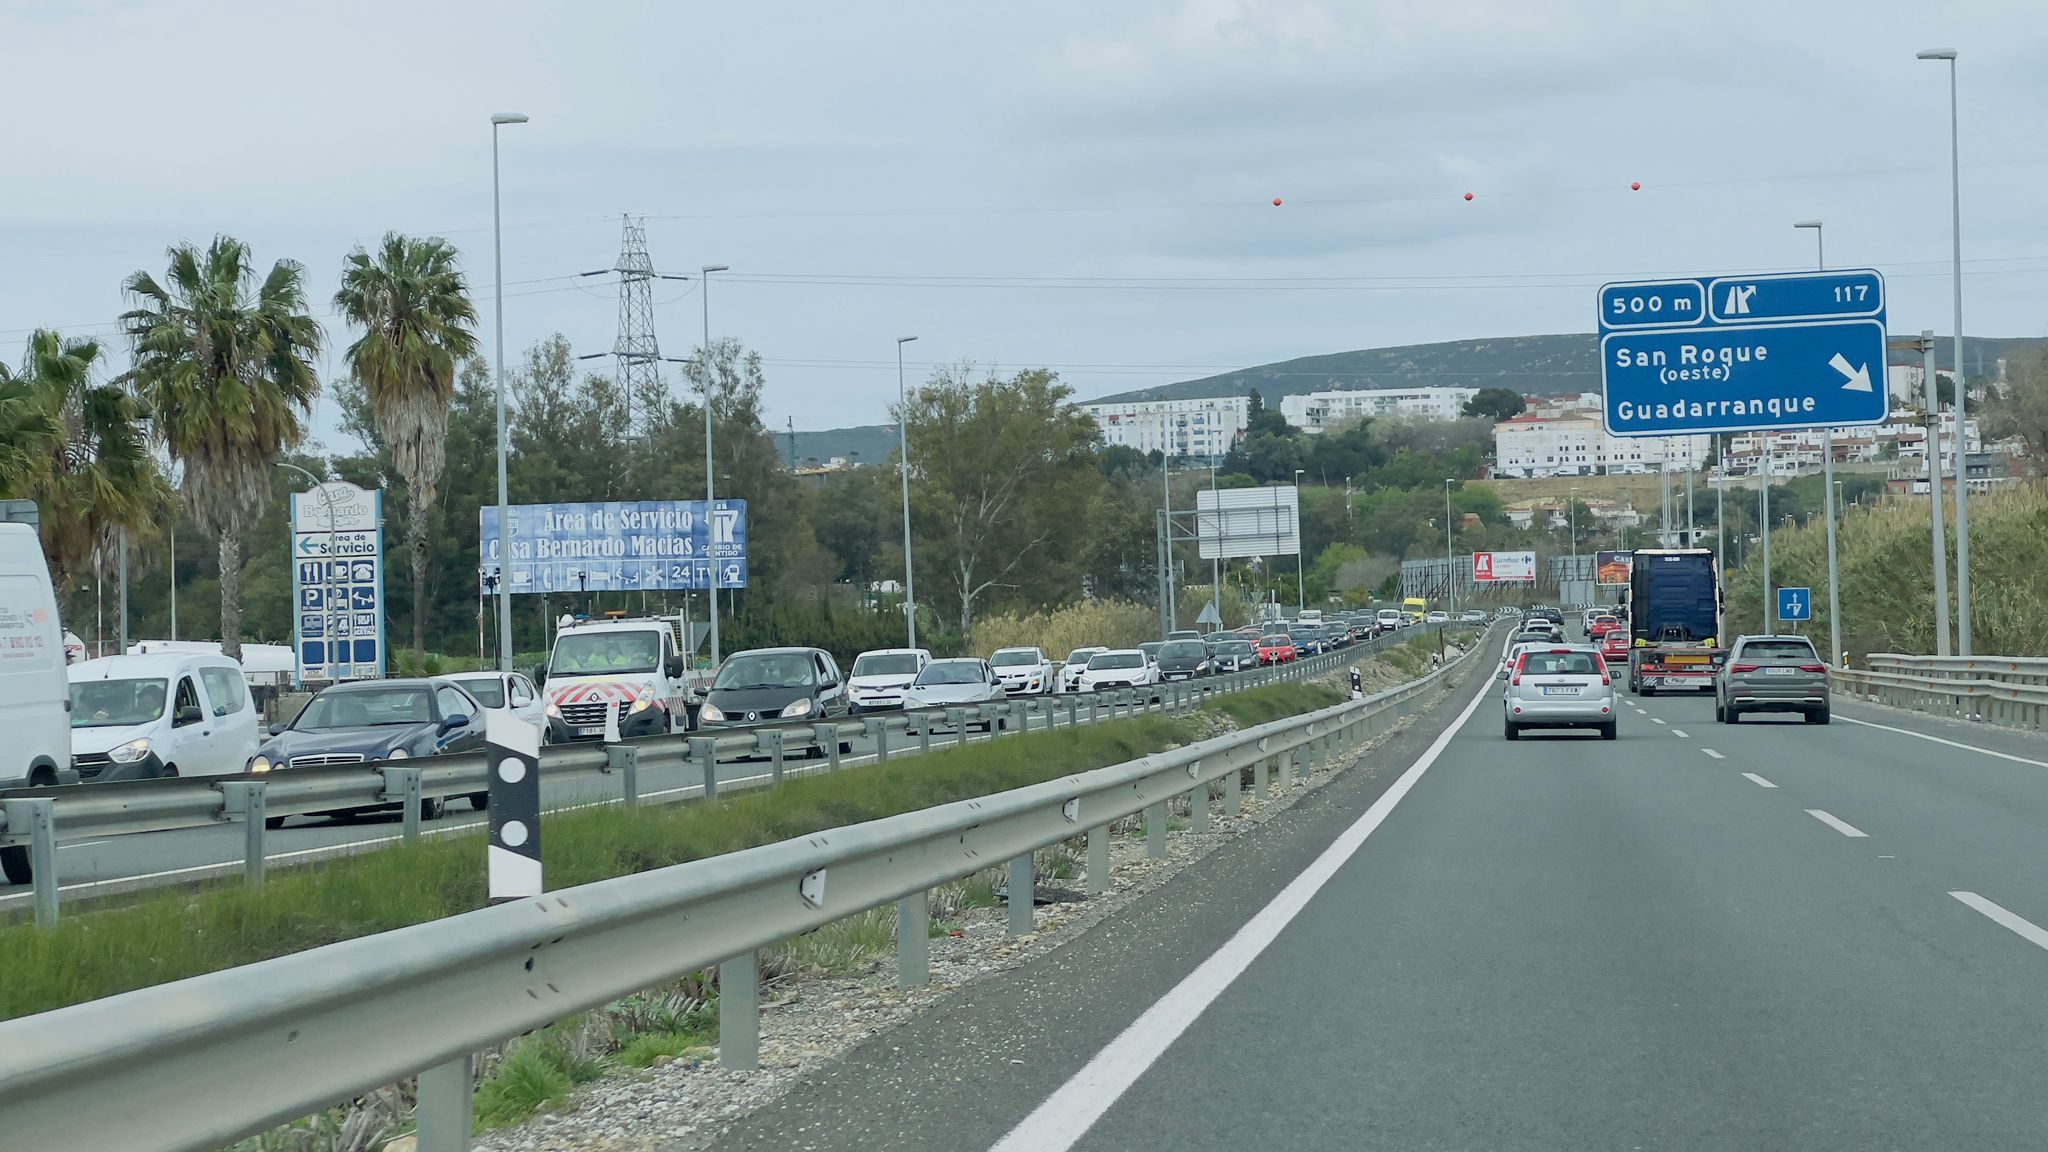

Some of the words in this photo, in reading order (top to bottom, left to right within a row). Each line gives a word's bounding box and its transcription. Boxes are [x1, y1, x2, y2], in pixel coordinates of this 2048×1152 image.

[1834, 285, 1869, 302] 117
[1613, 296, 1662, 314] 500
[1674, 297, 1691, 311] m
[1616, 348, 1666, 367] San
[1680, 345, 1768, 367] Roque
[1659, 364, 1731, 385] (oeste)
[1617, 396, 1816, 421] Guadarranque
[544, 507, 586, 532] Área
[592, 509, 615, 530] de
[620, 508, 693, 530] Servicio
[354, 533, 366, 541] de
[489, 538, 531, 560] Csa
[537, 536, 626, 559] Bernardo
[732, 543, 743, 551] DE
[671, 565, 691, 578] 24
